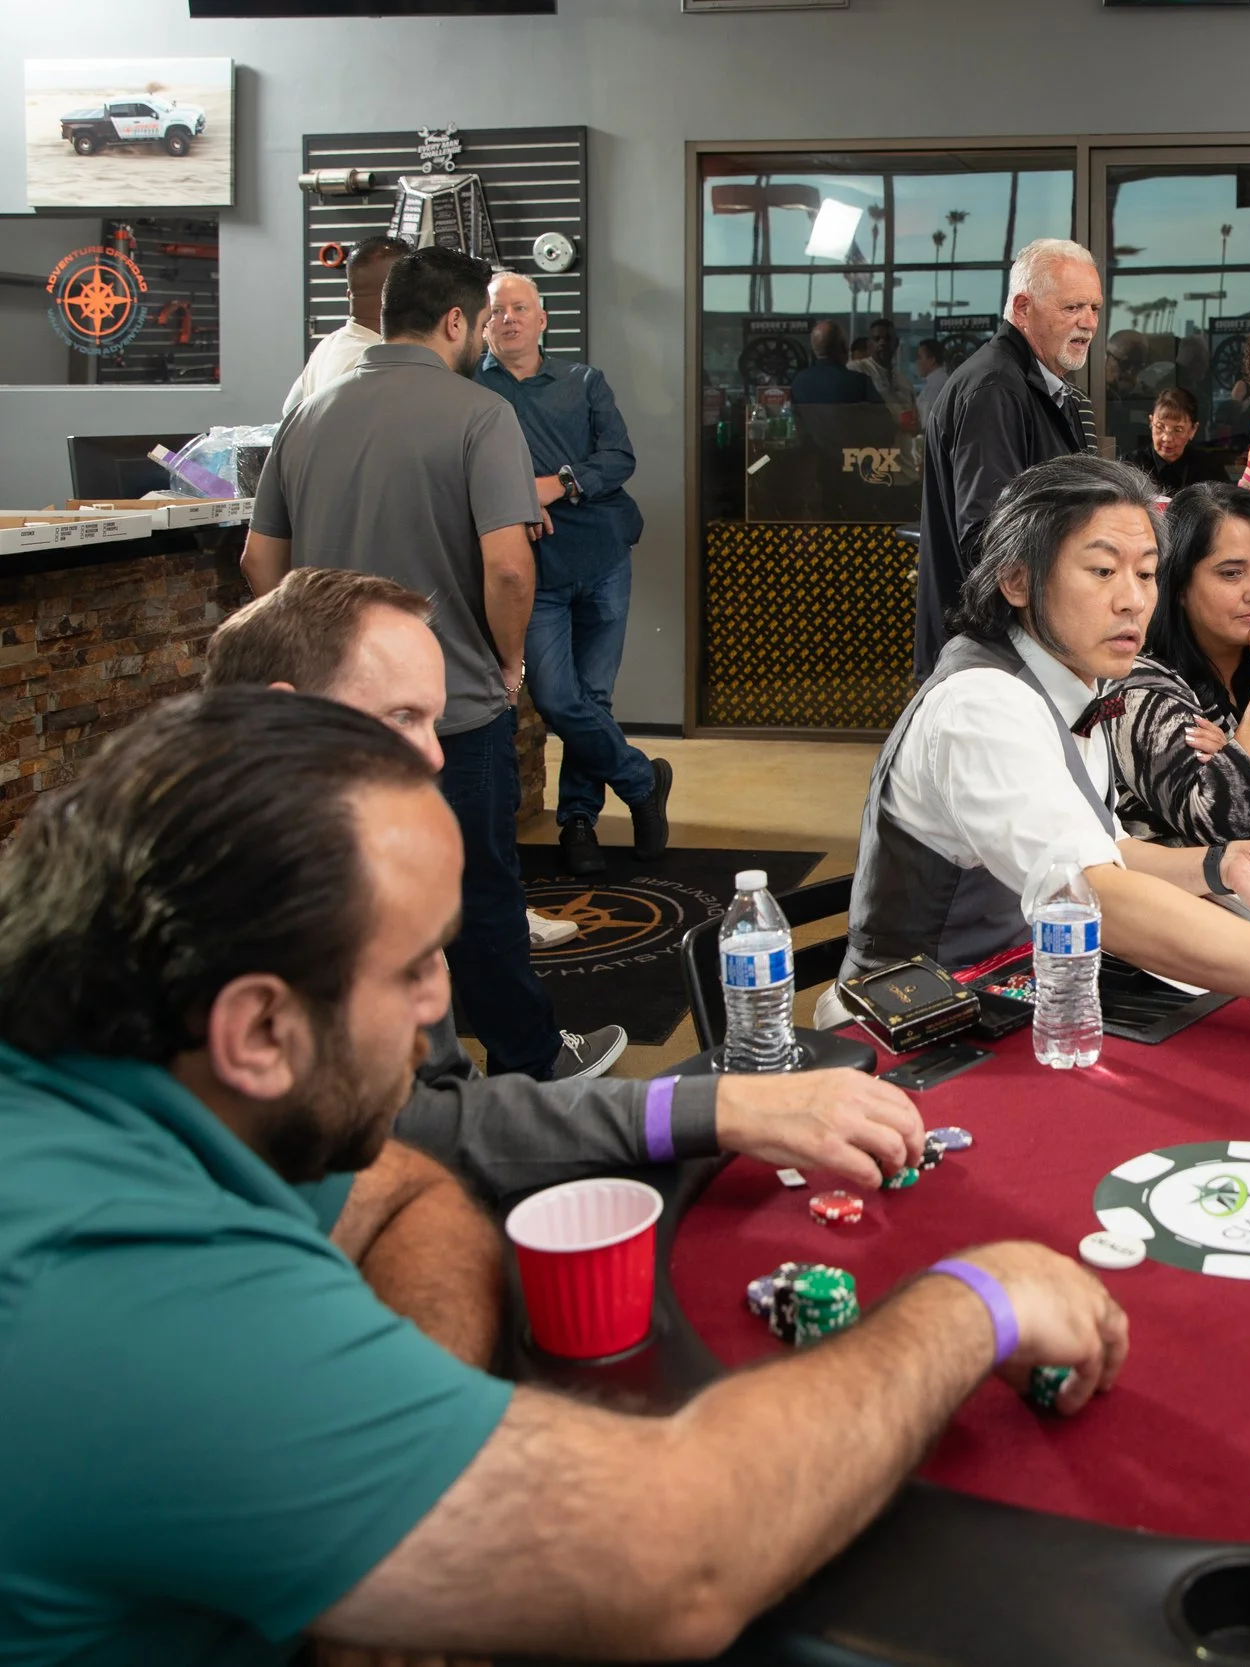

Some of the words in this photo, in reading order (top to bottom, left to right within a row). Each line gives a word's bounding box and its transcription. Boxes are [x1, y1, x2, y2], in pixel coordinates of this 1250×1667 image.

[417, 143, 440, 154] EVERY
[441, 139, 460, 150] MAN
[420, 145, 462, 159] CHALLENGE
[45, 246, 104, 294] ADVENTURE
[105, 247, 149, 293] OFFROAD
[73, 342, 101, 355] YOUR
[842, 447, 901, 486] FOX
[630, 876, 726, 918] DVENTURE
